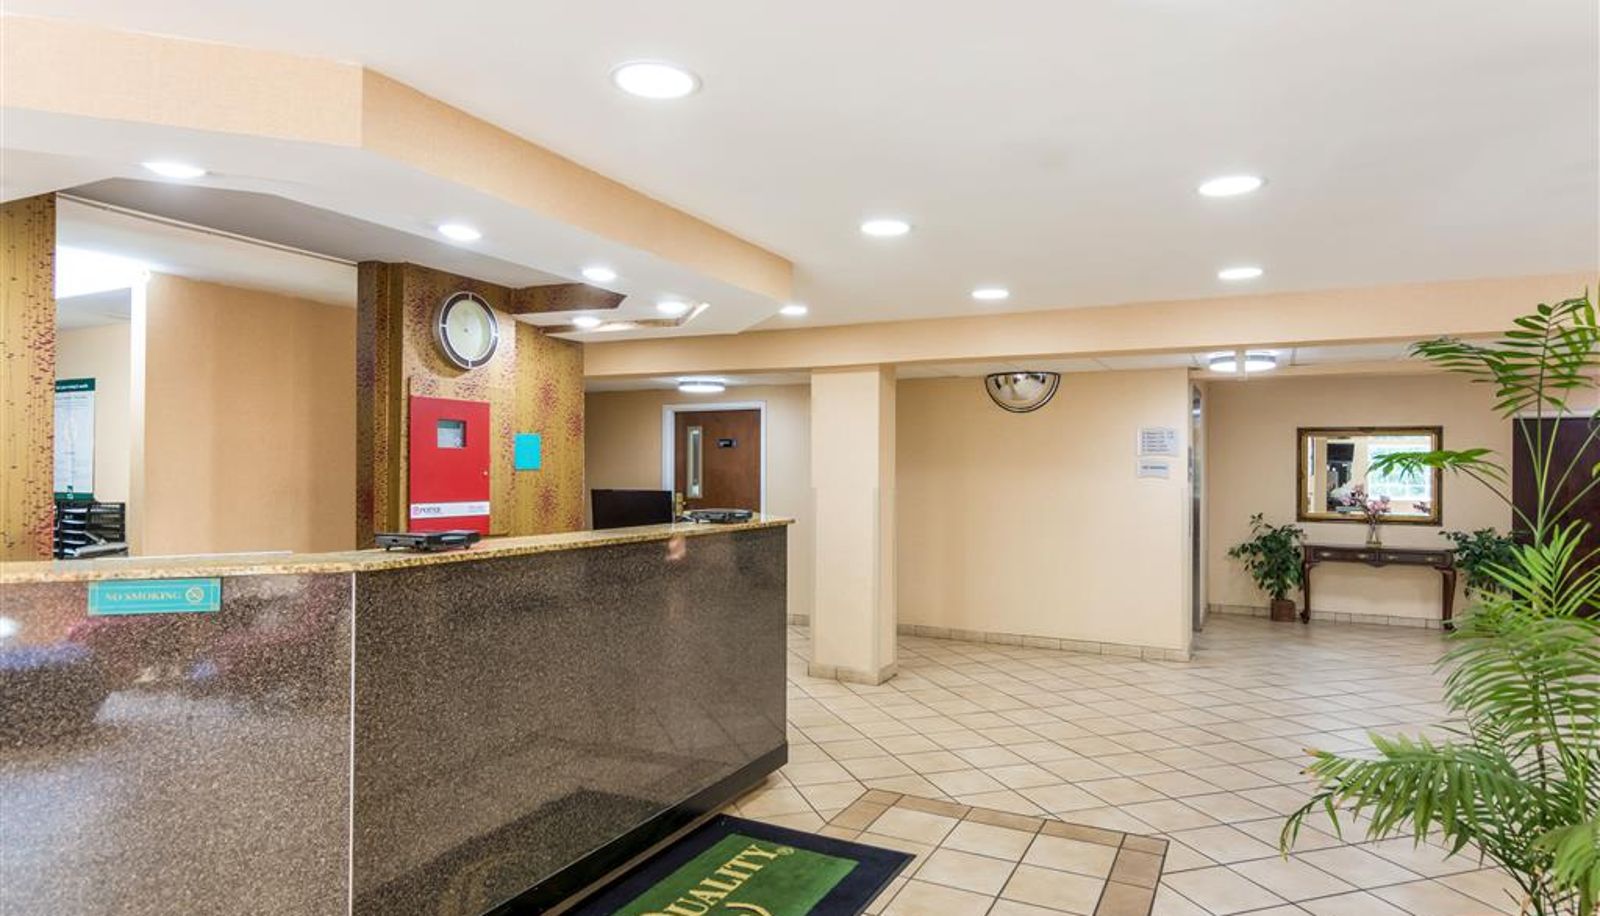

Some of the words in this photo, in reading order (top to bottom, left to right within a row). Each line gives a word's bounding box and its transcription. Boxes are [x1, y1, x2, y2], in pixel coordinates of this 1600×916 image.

[105, 592, 122, 601] NO
[124, 590, 181, 601] SMOKING
[641, 844, 778, 916] UALITY
